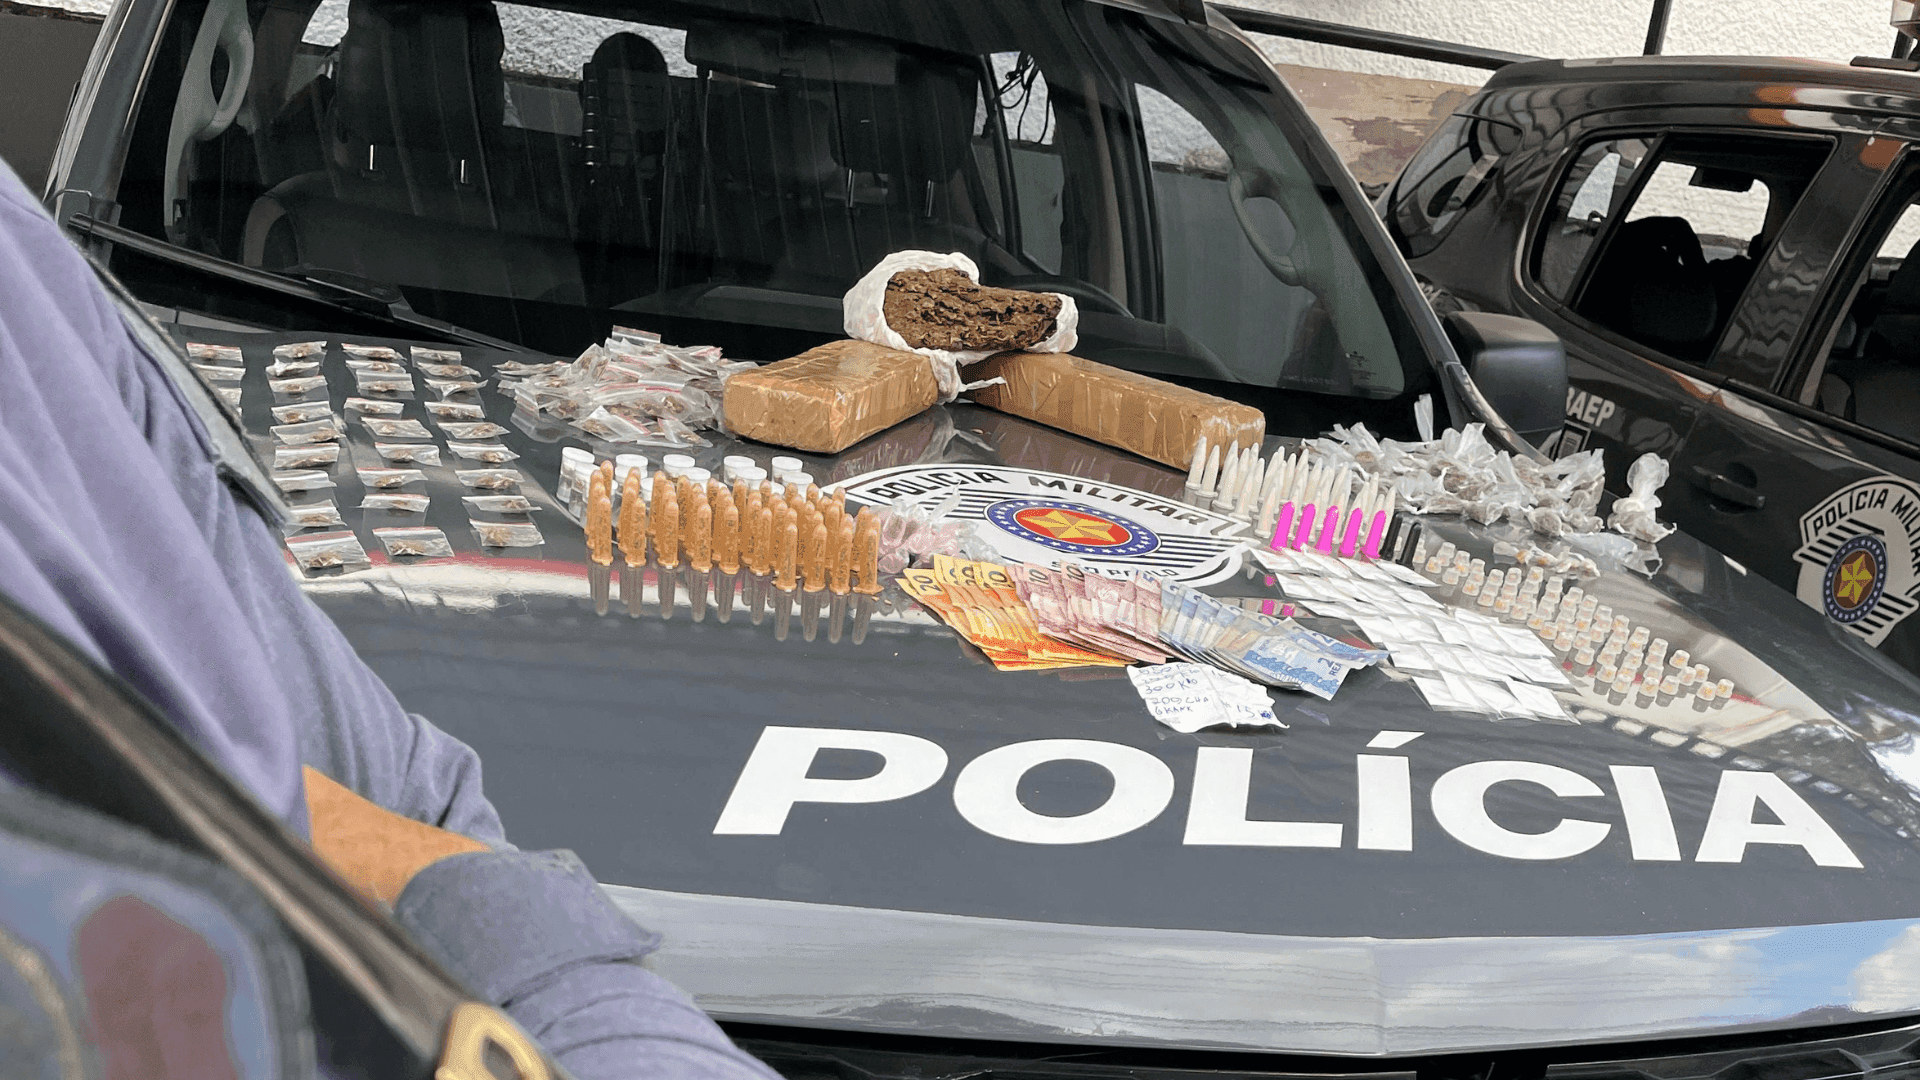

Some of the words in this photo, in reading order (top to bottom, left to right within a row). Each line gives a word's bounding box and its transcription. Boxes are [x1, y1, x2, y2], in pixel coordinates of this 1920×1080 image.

[1028, 475, 1209, 526] MILITAR
[1028, 568, 1050, 585] 10
[1066, 564, 1086, 582] 10
[1317, 657, 1336, 668] 2
[713, 725, 1866, 869] POLÍCIA
